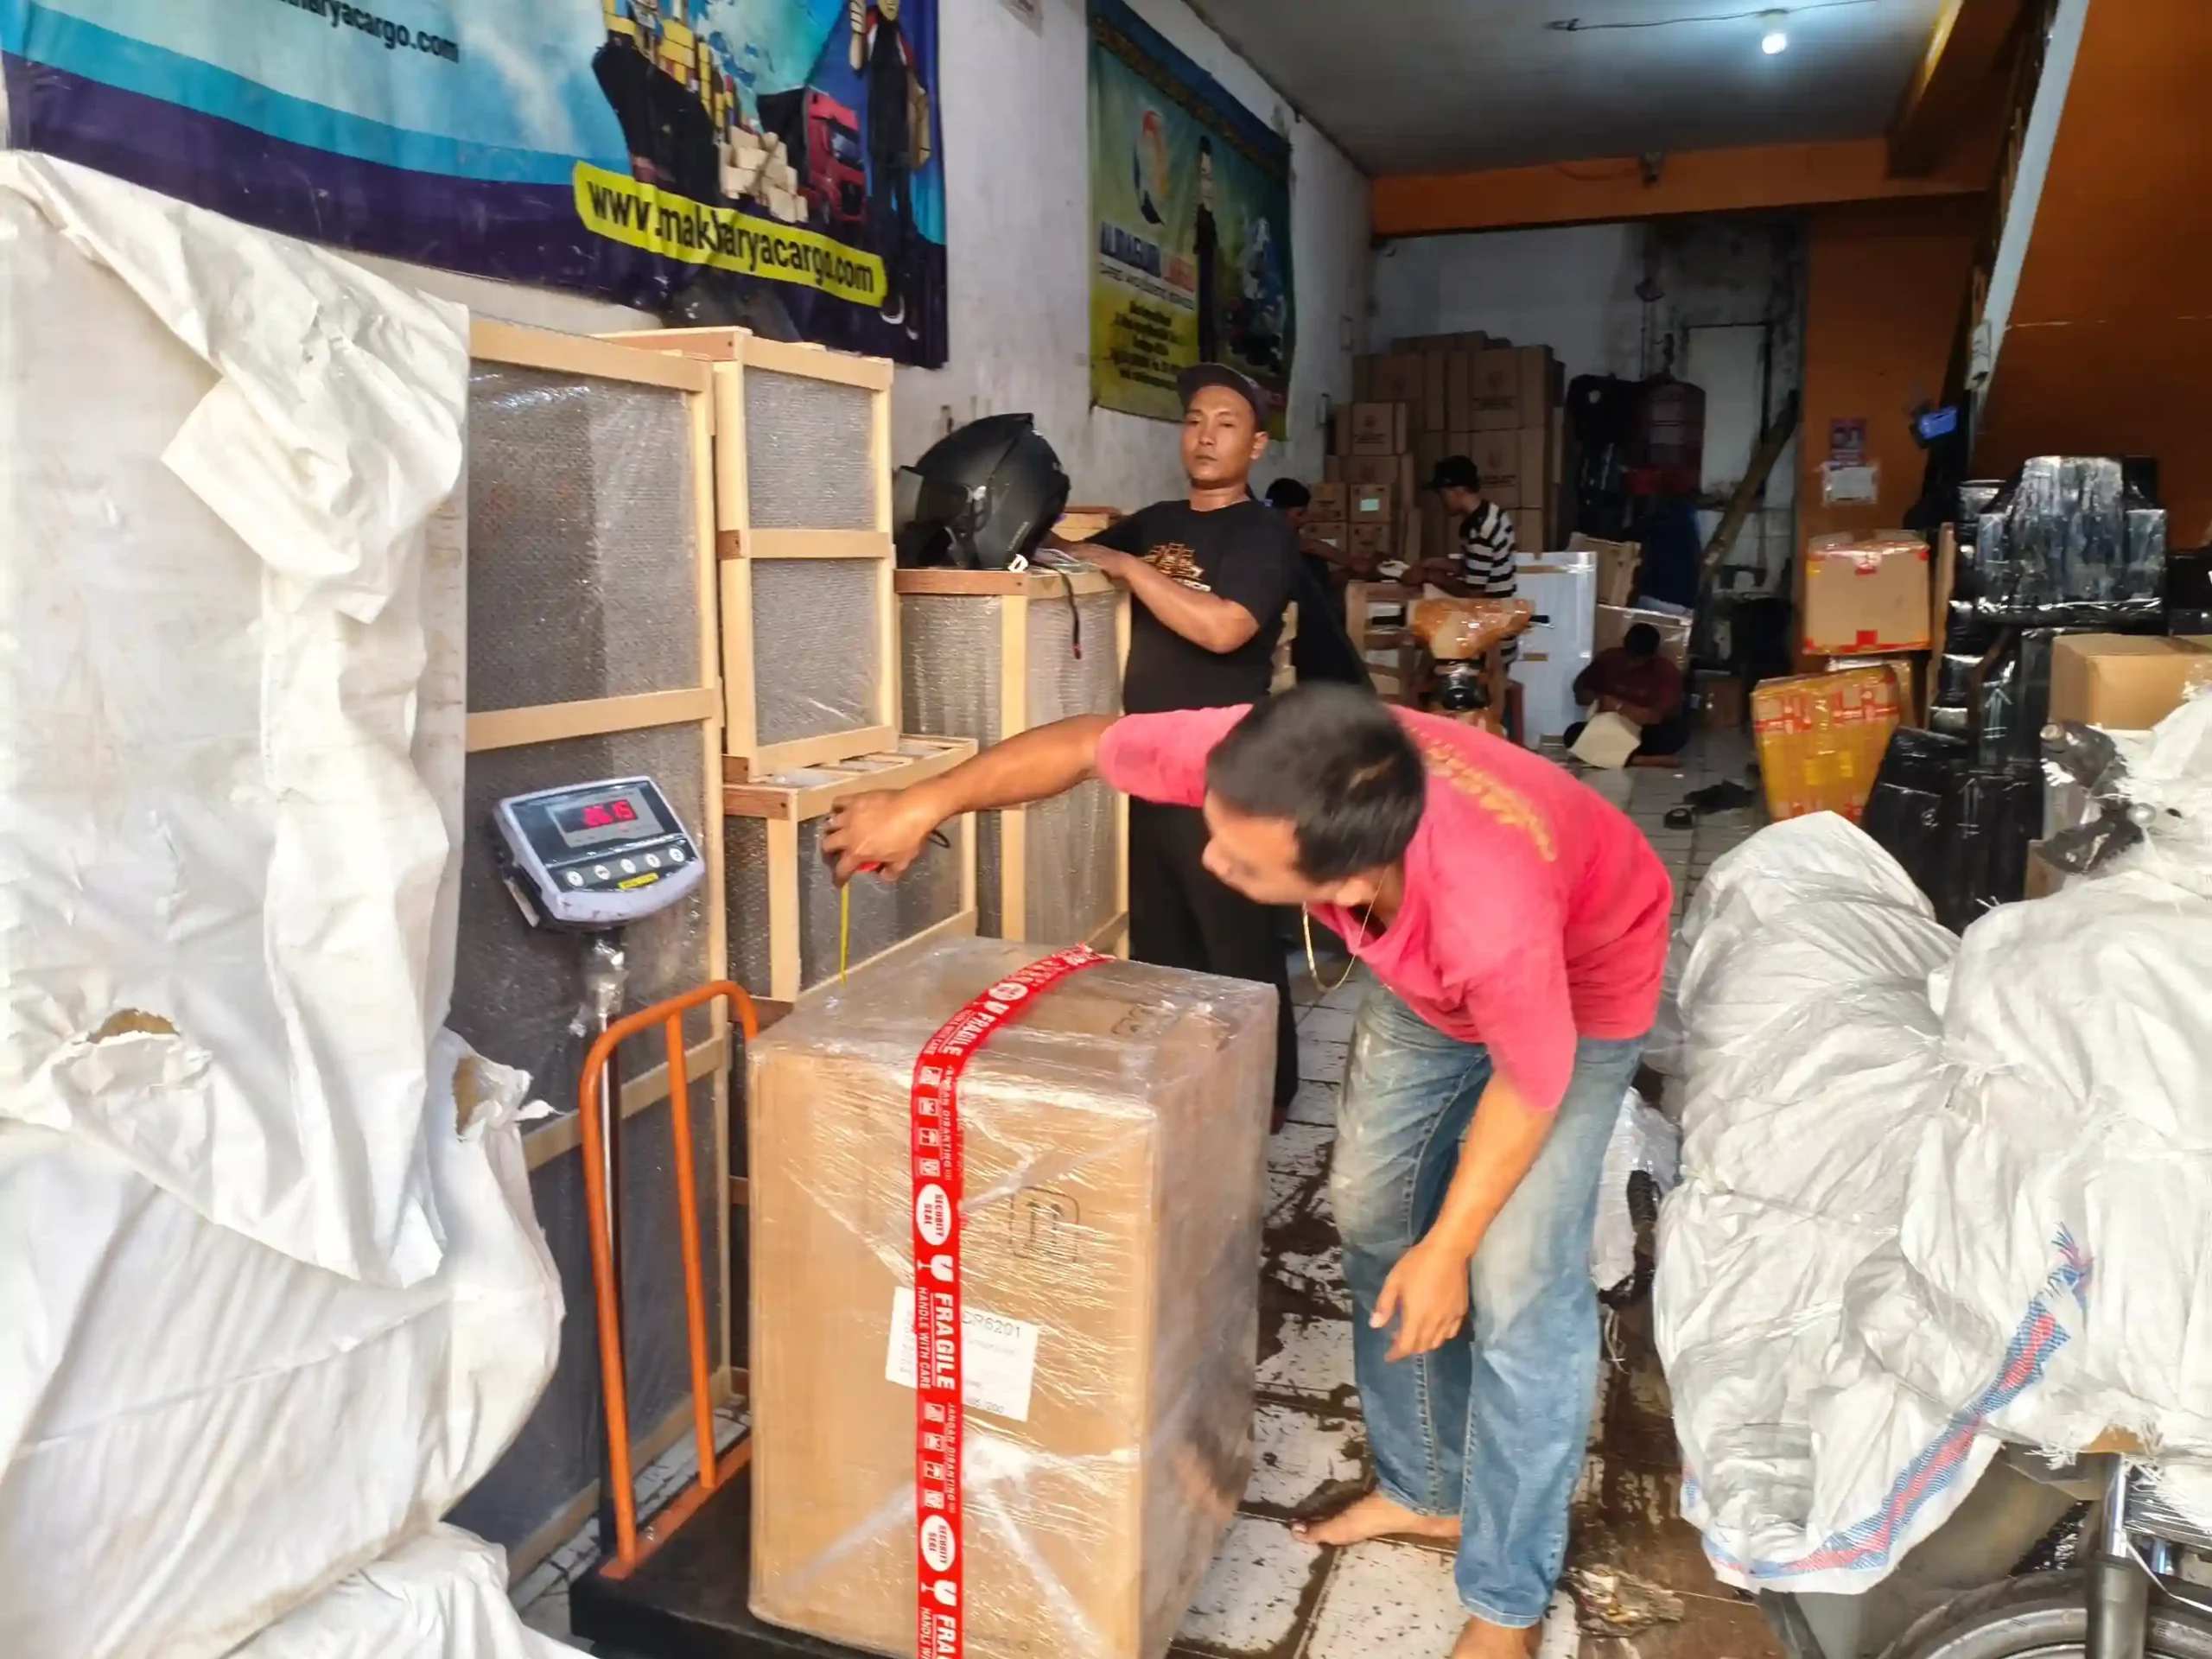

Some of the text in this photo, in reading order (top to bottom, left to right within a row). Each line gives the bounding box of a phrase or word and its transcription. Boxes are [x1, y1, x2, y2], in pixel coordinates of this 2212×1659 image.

[943, 1011, 997, 1057] FRAGILE
[917, 1287, 931, 1329] HANDLE
[918, 1332, 931, 1359] WITH
[934, 1292, 956, 1391] FRAGILE
[937, 1614, 957, 1659] FRA
